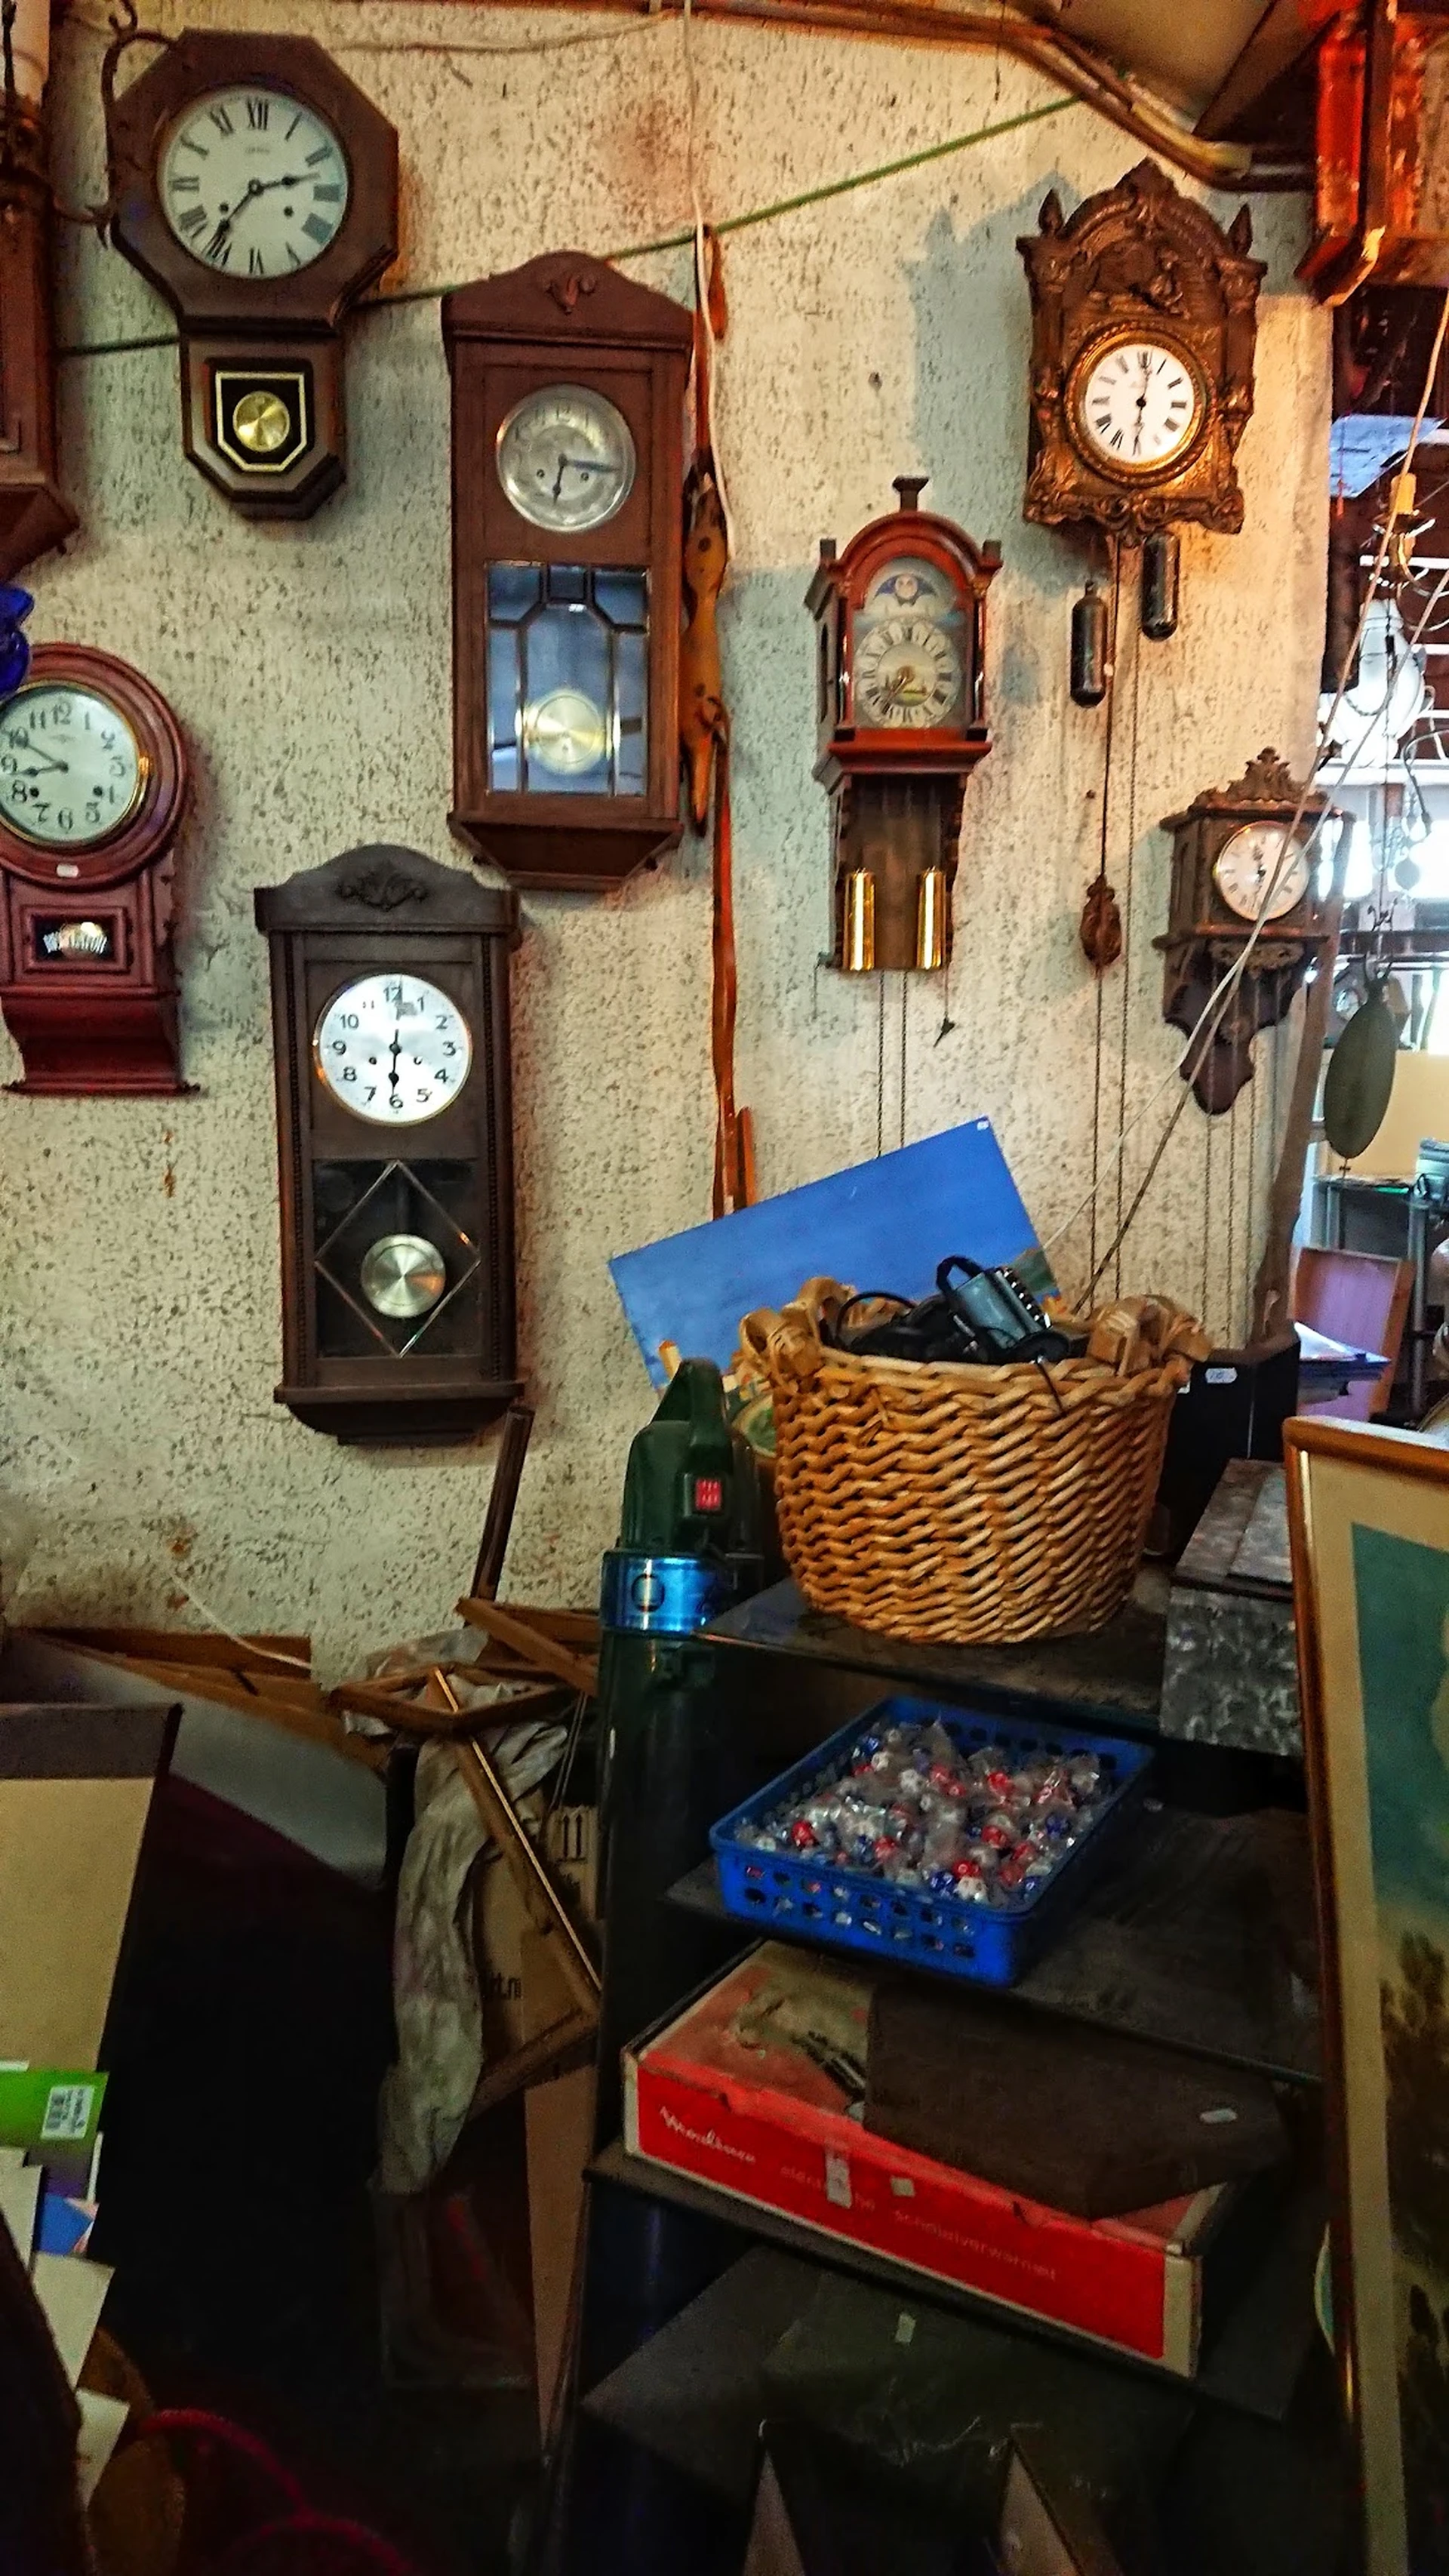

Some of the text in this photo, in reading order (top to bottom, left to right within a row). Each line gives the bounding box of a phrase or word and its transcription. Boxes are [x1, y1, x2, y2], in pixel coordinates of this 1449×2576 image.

[29, 709, 46, 731] 11
[51, 699, 72, 725] 12
[11, 780, 28, 804] 8
[417, 995, 425, 1012] 1
[340, 1013, 359, 1029] 10
[435, 1014, 450, 1030] 2
[331, 1039, 347, 1056] 9
[442, 1041, 457, 1057] 3
[343, 1066, 358, 1082] 8
[433, 1066, 449, 1084] 4
[364, 1085, 377, 1103] 7
[389, 1094, 404, 1109] 6
[416, 1088, 432, 1103] 5
